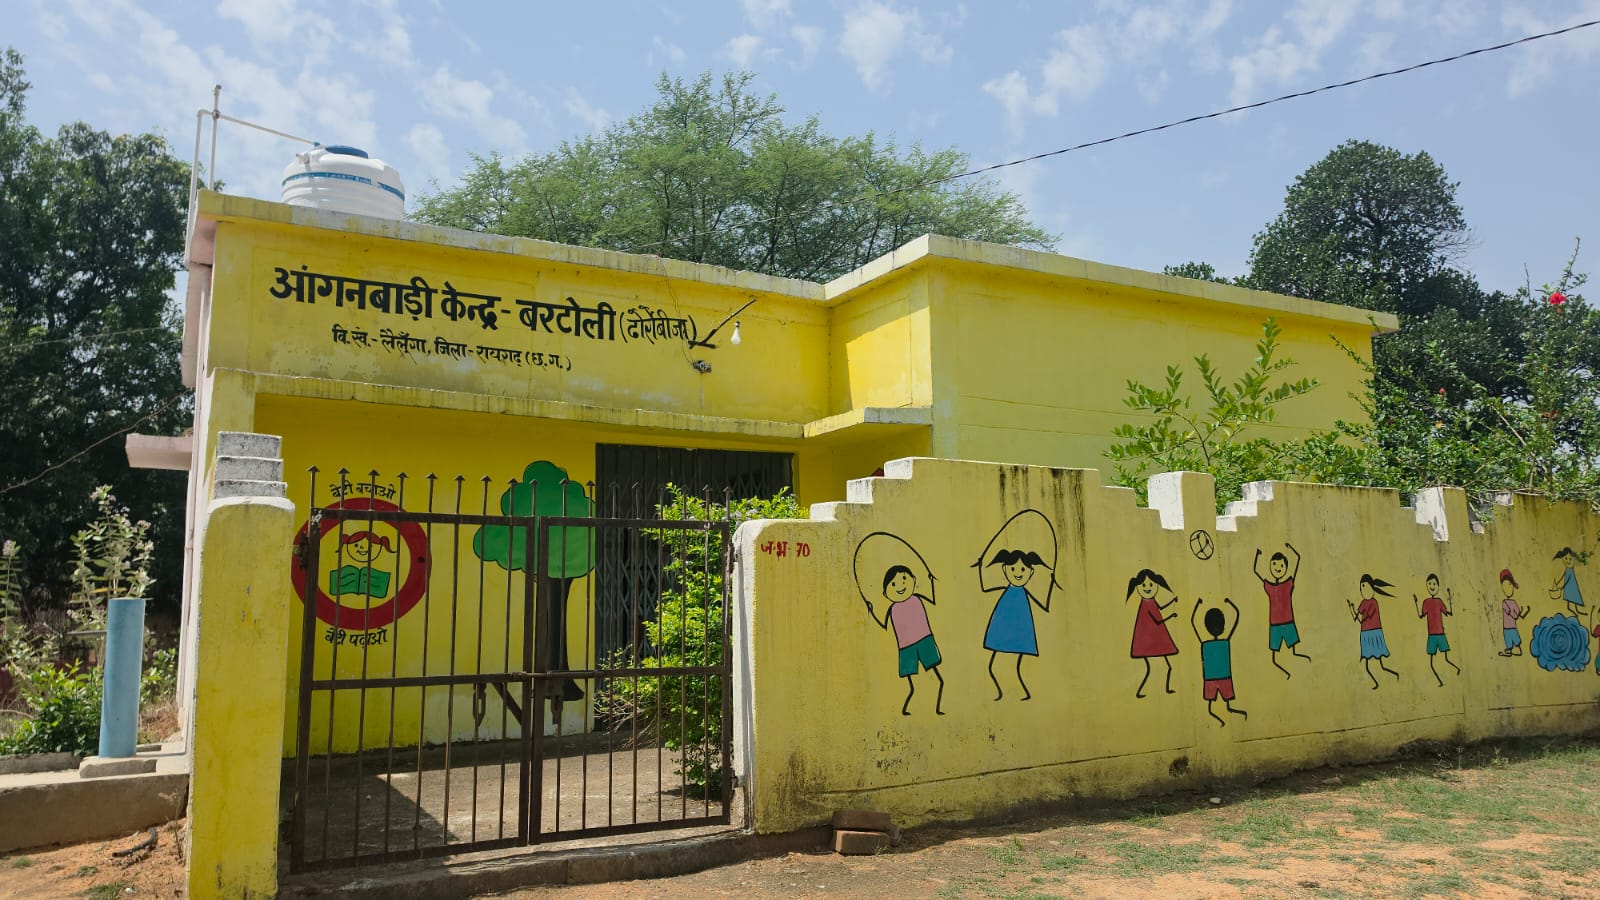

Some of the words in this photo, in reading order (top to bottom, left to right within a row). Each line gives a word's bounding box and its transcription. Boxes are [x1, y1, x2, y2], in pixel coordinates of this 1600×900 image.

[269, 264, 437, 322] आंगनबाड़ी
[515, 297, 617, 341] बरटोली
[325, 627, 346, 646] बेटी
